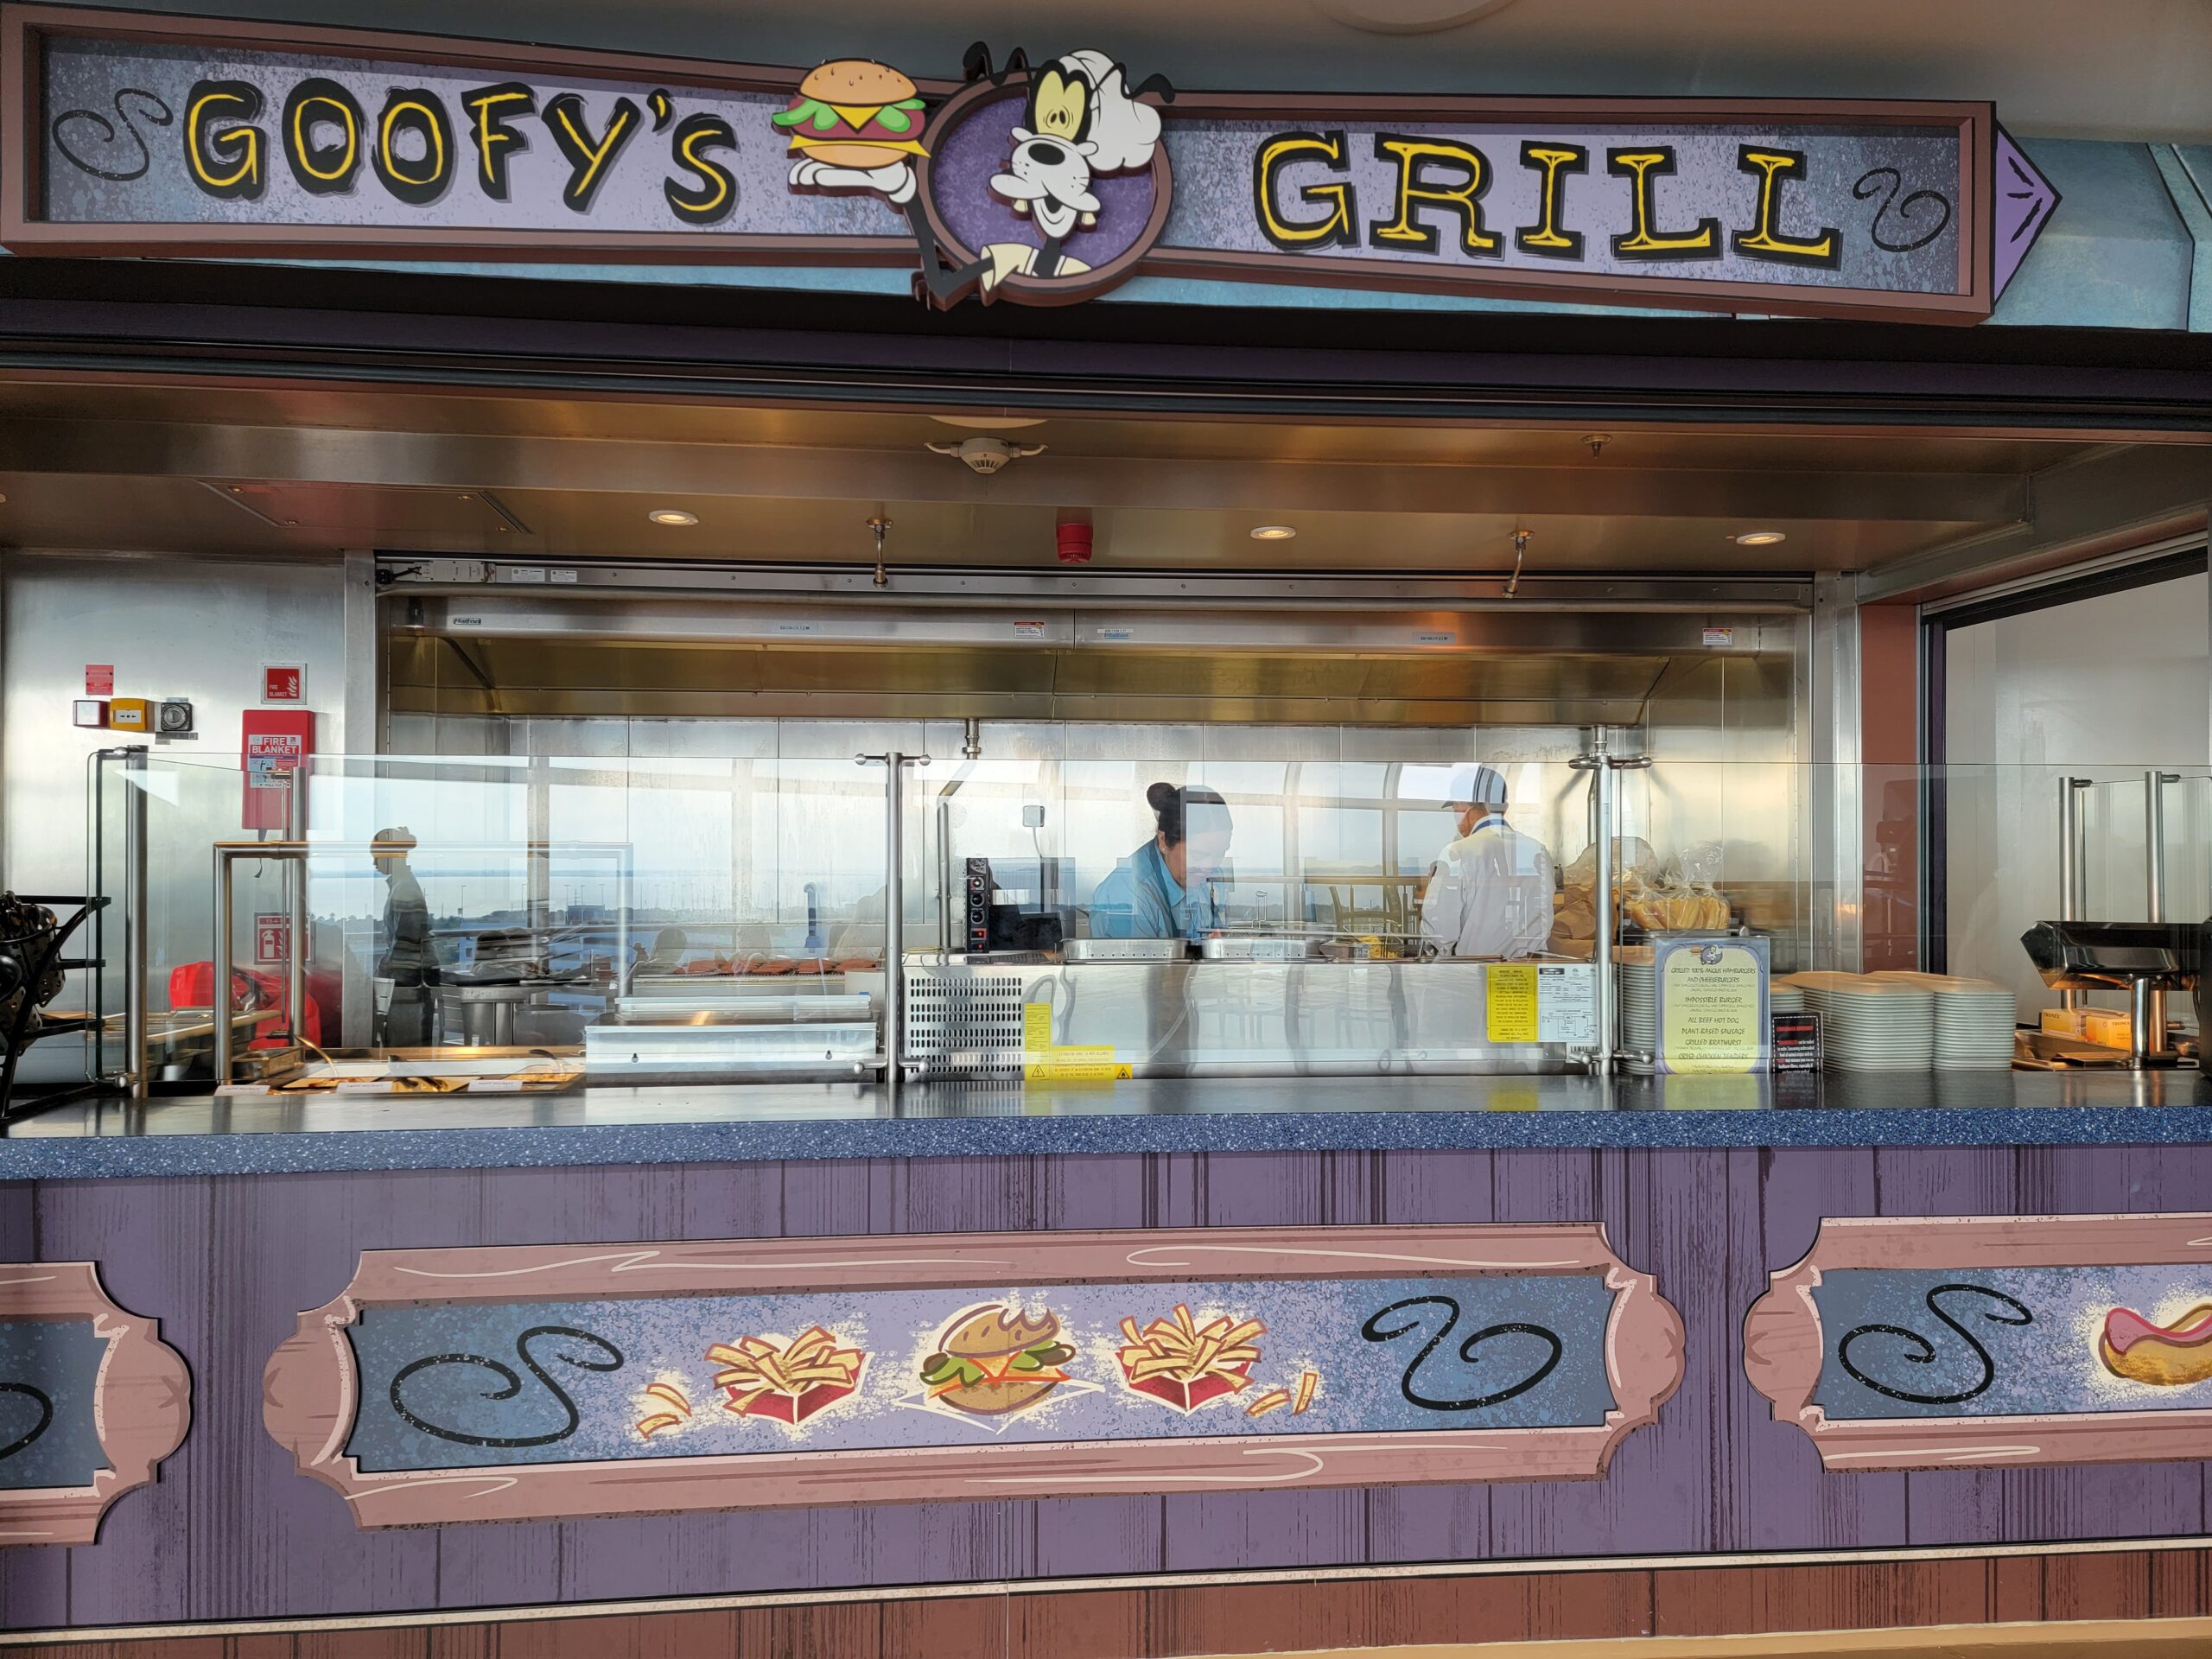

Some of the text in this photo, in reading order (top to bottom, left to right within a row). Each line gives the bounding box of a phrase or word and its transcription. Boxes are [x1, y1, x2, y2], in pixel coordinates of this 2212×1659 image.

[182, 77, 1840, 269] GOOFY'S GRILL
[264, 737, 286, 746] FIRE
[251, 745, 297, 754] BLANKET
